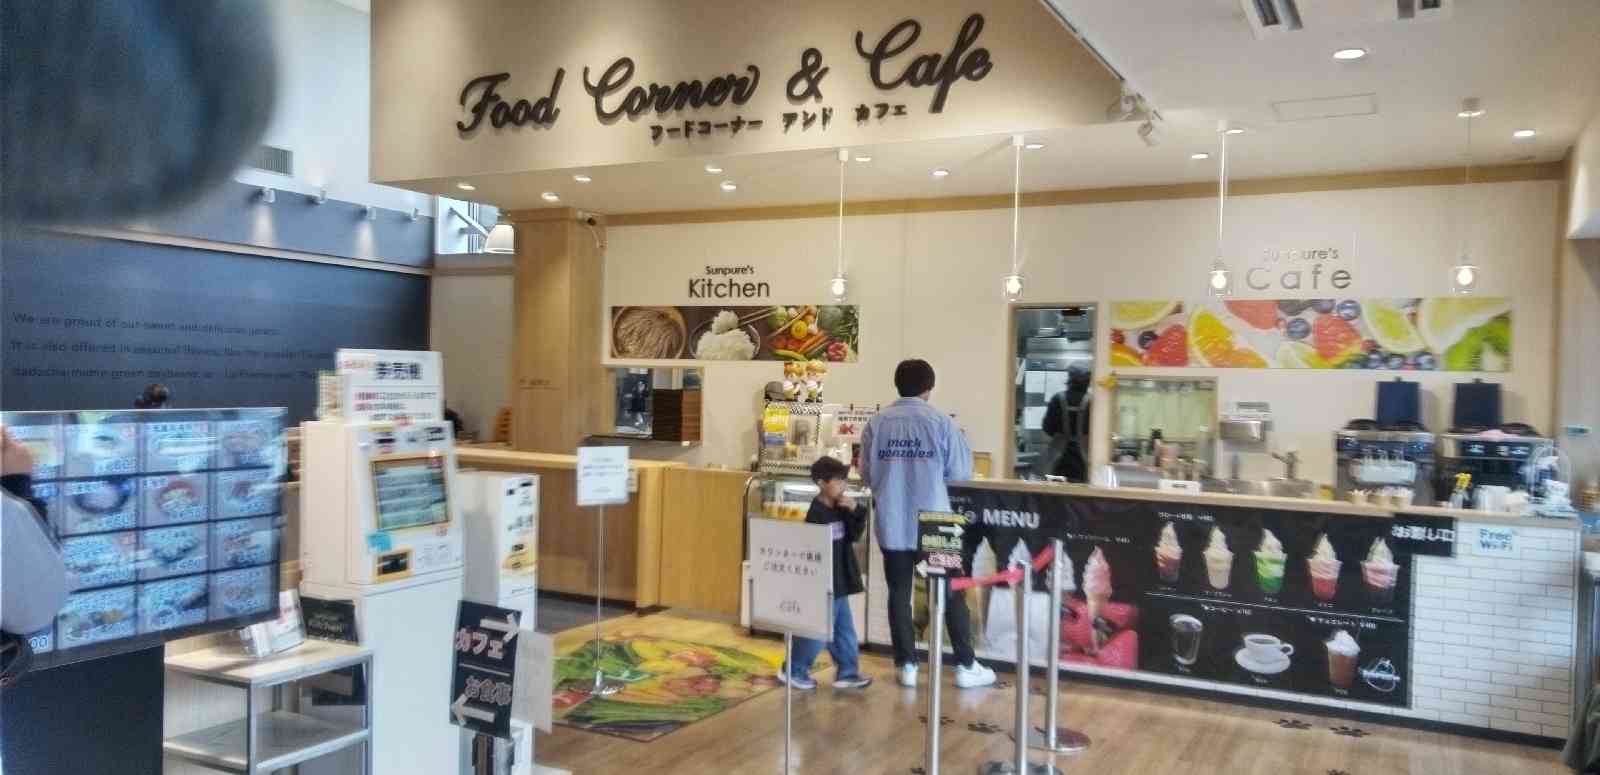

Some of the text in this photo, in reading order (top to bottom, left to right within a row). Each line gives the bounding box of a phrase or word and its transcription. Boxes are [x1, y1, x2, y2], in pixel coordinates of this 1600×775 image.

[457, 12, 993, 134] Food Corner & Cafe
[649, 102, 907, 142] フードコーナー アンド カフェ
[705, 264, 755, 276] Sunpure's
[1246, 263, 1353, 291] Cafe
[687, 277, 771, 298] Kitchen
[982, 507, 1040, 529] MENU
[1480, 527, 1513, 541] Free
[455, 627, 505, 660] カフェ
[465, 675, 513, 706] お食事
